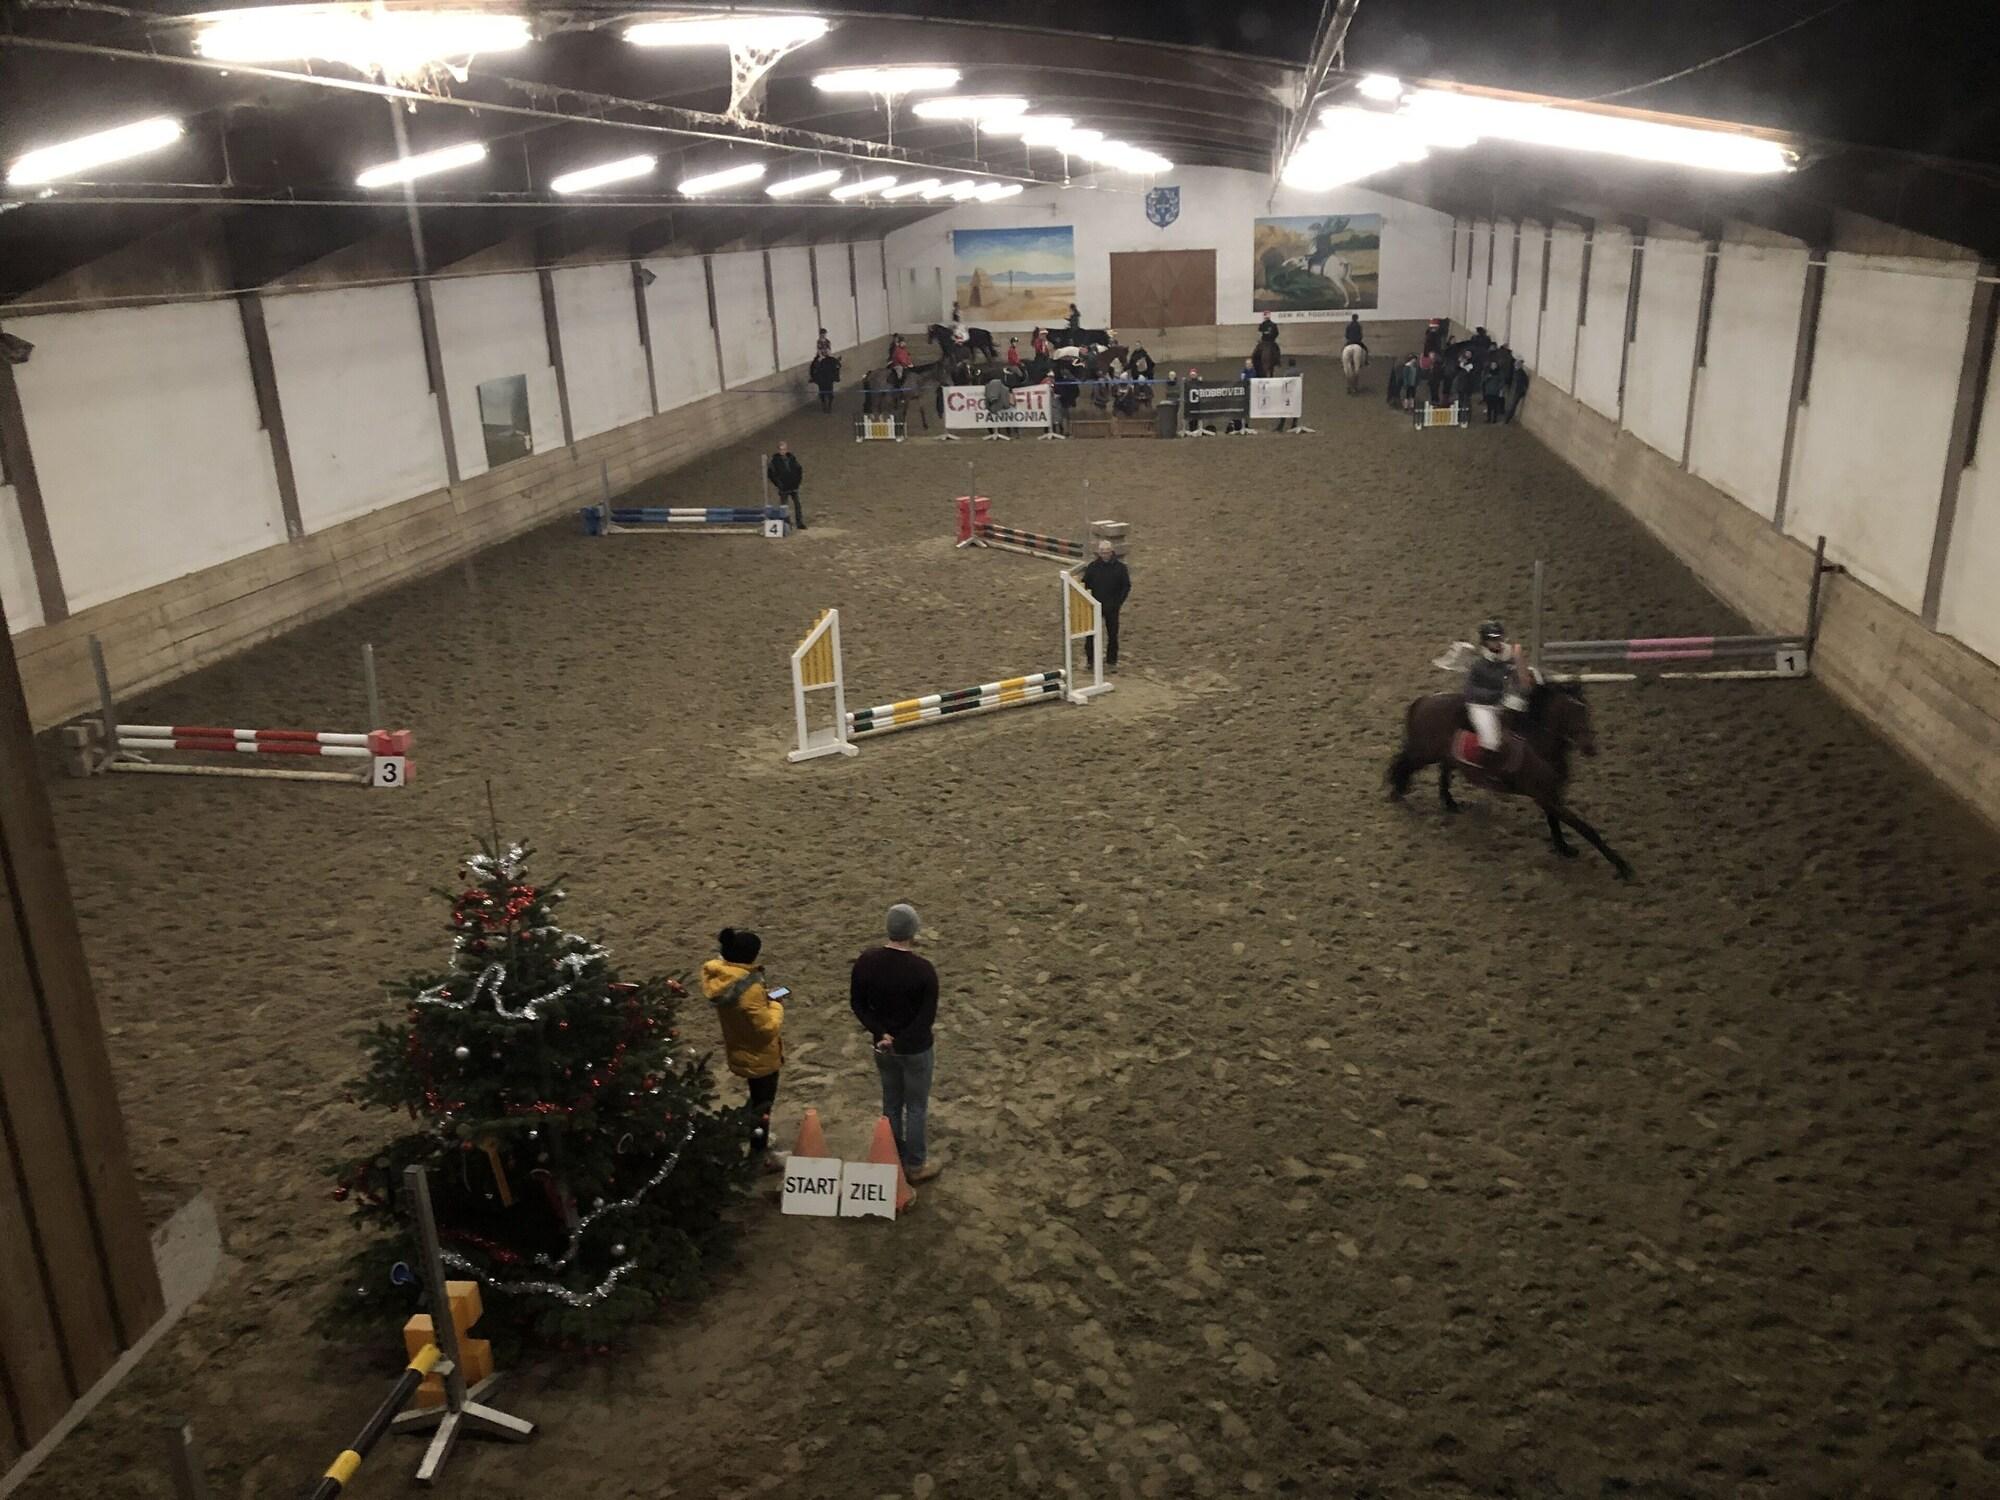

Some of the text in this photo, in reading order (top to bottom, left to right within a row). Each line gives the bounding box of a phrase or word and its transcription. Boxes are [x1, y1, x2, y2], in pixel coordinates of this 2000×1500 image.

[947, 391, 1046, 411] CROFIT
[975, 411, 1047, 423] PANNONIA
[769, 523, 778, 536] 4
[1784, 656, 1795, 671] 1
[382, 762, 397, 783] 3
[785, 1176, 838, 1195] START
[850, 1183, 887, 1202] ZIEL
